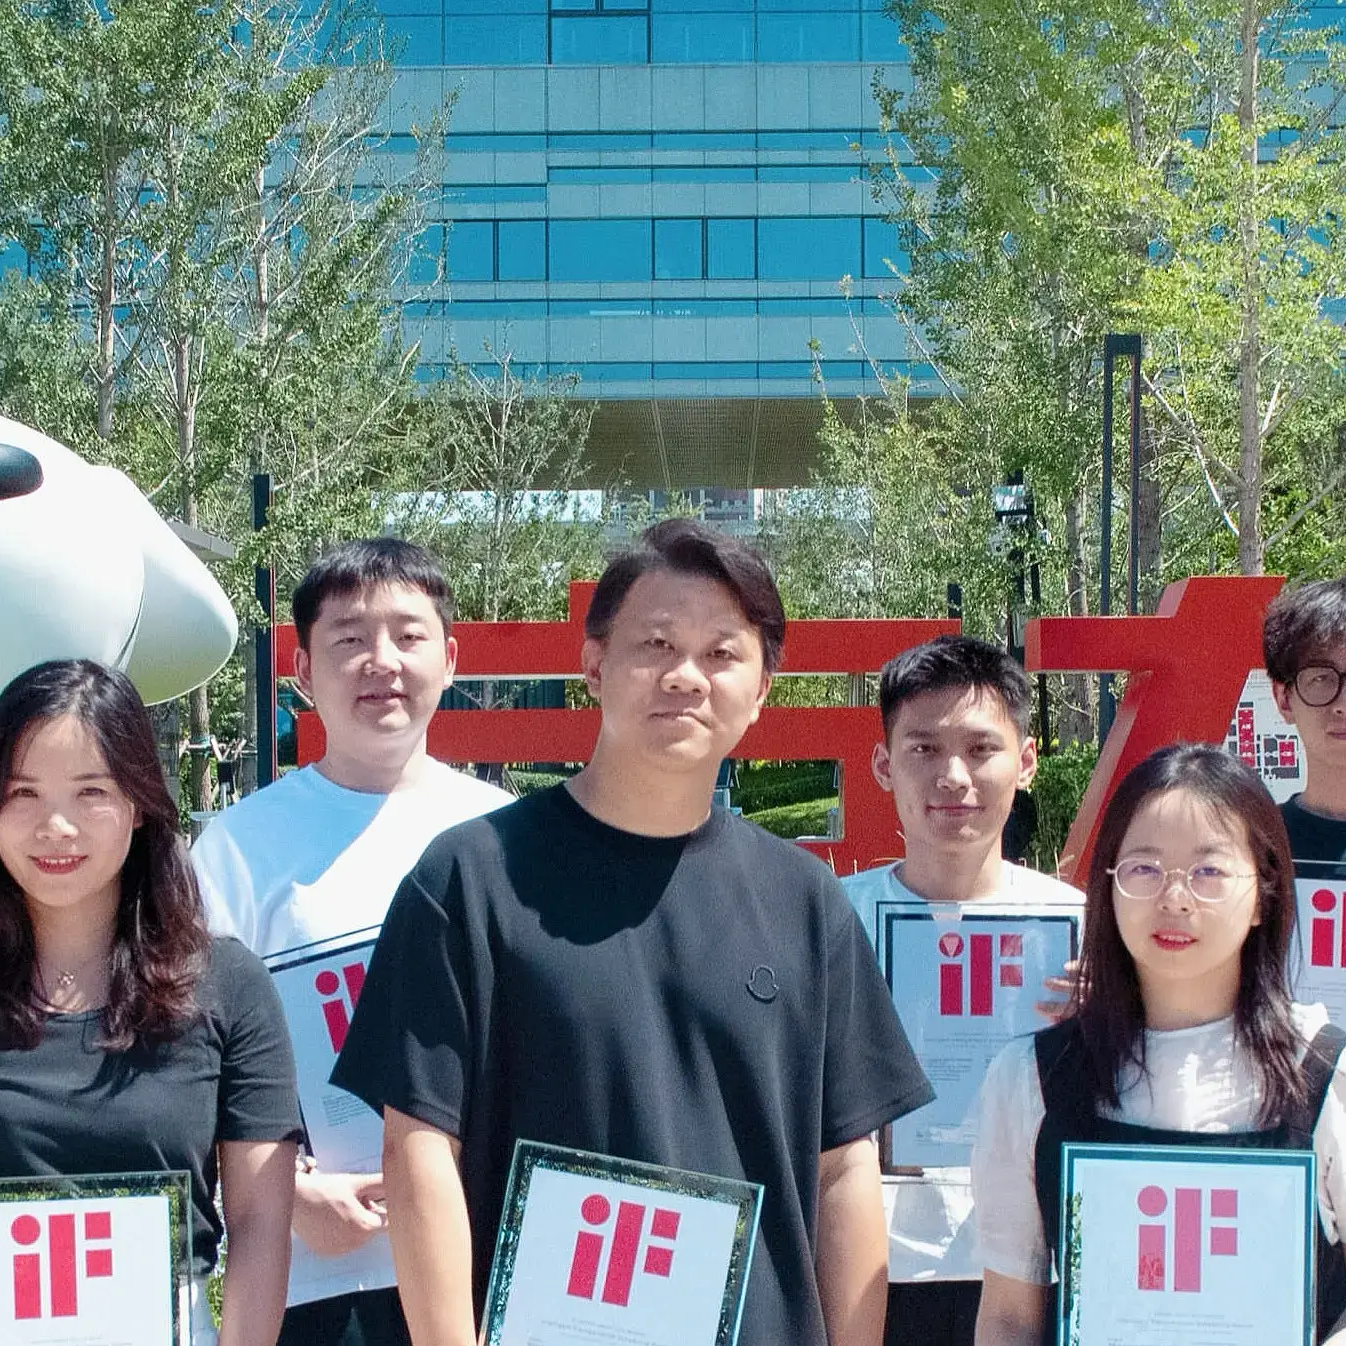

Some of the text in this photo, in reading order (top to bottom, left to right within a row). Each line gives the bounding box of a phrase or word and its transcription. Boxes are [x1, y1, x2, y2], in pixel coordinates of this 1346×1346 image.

[938, 932, 1023, 1016] iF
[10, 1211, 113, 1320] iF
[566, 1193, 681, 1307] iF
[1137, 1185, 1238, 1292] iF
